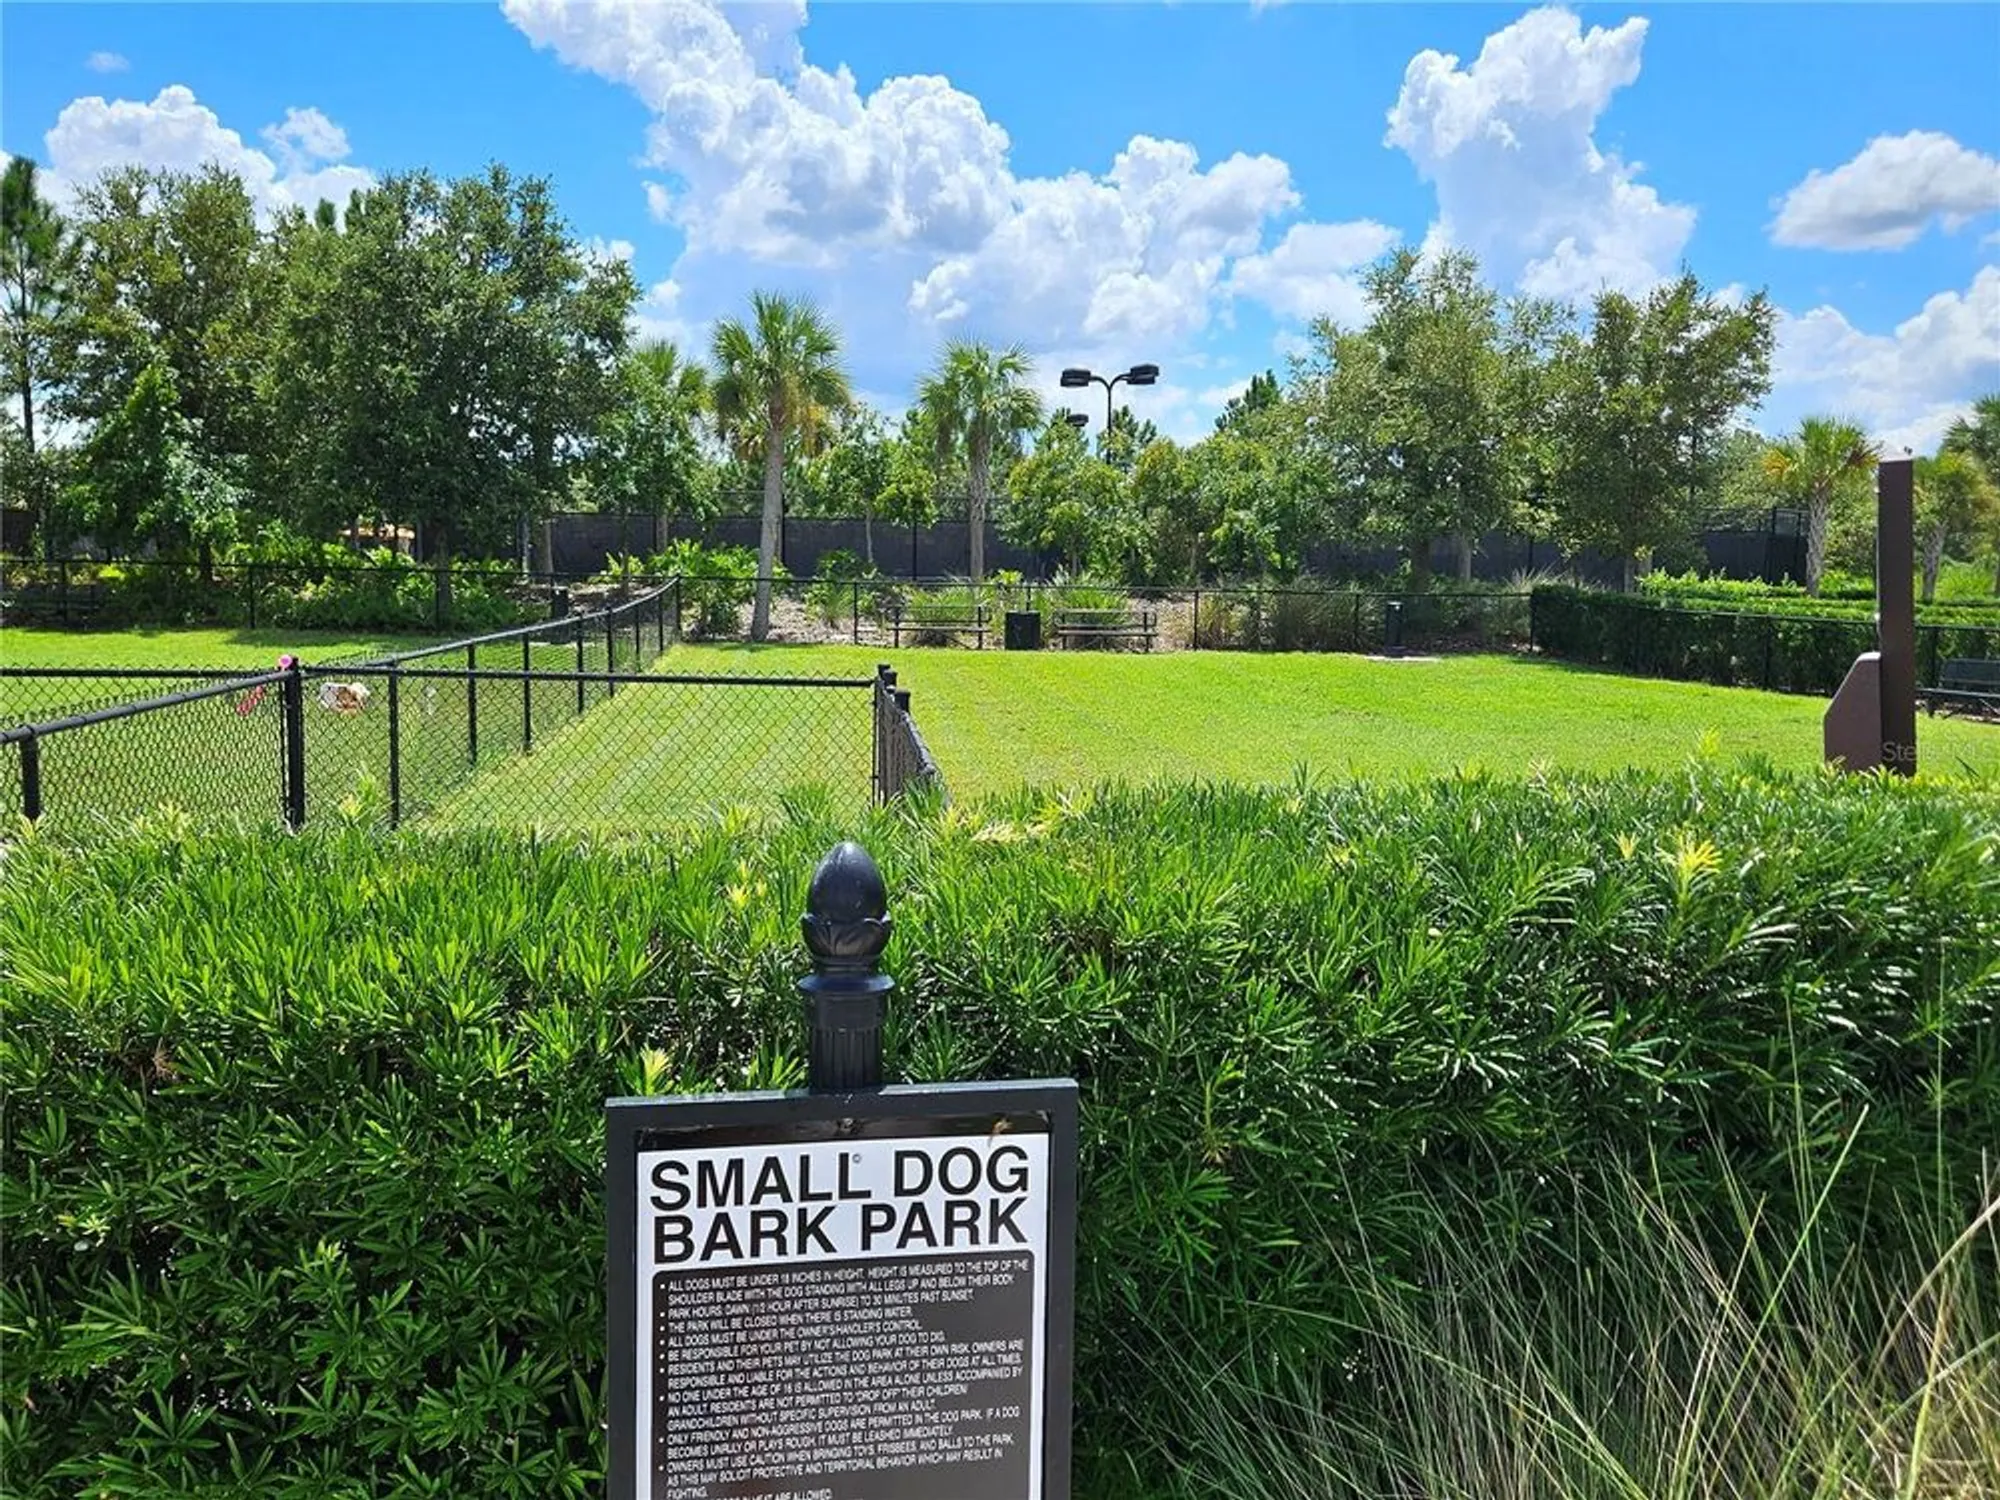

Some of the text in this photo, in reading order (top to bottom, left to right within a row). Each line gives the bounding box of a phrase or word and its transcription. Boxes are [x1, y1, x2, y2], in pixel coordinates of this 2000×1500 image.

[650, 1145, 1028, 1211] SMALL DOG
[654, 1197, 1027, 1264] BARK PARK
